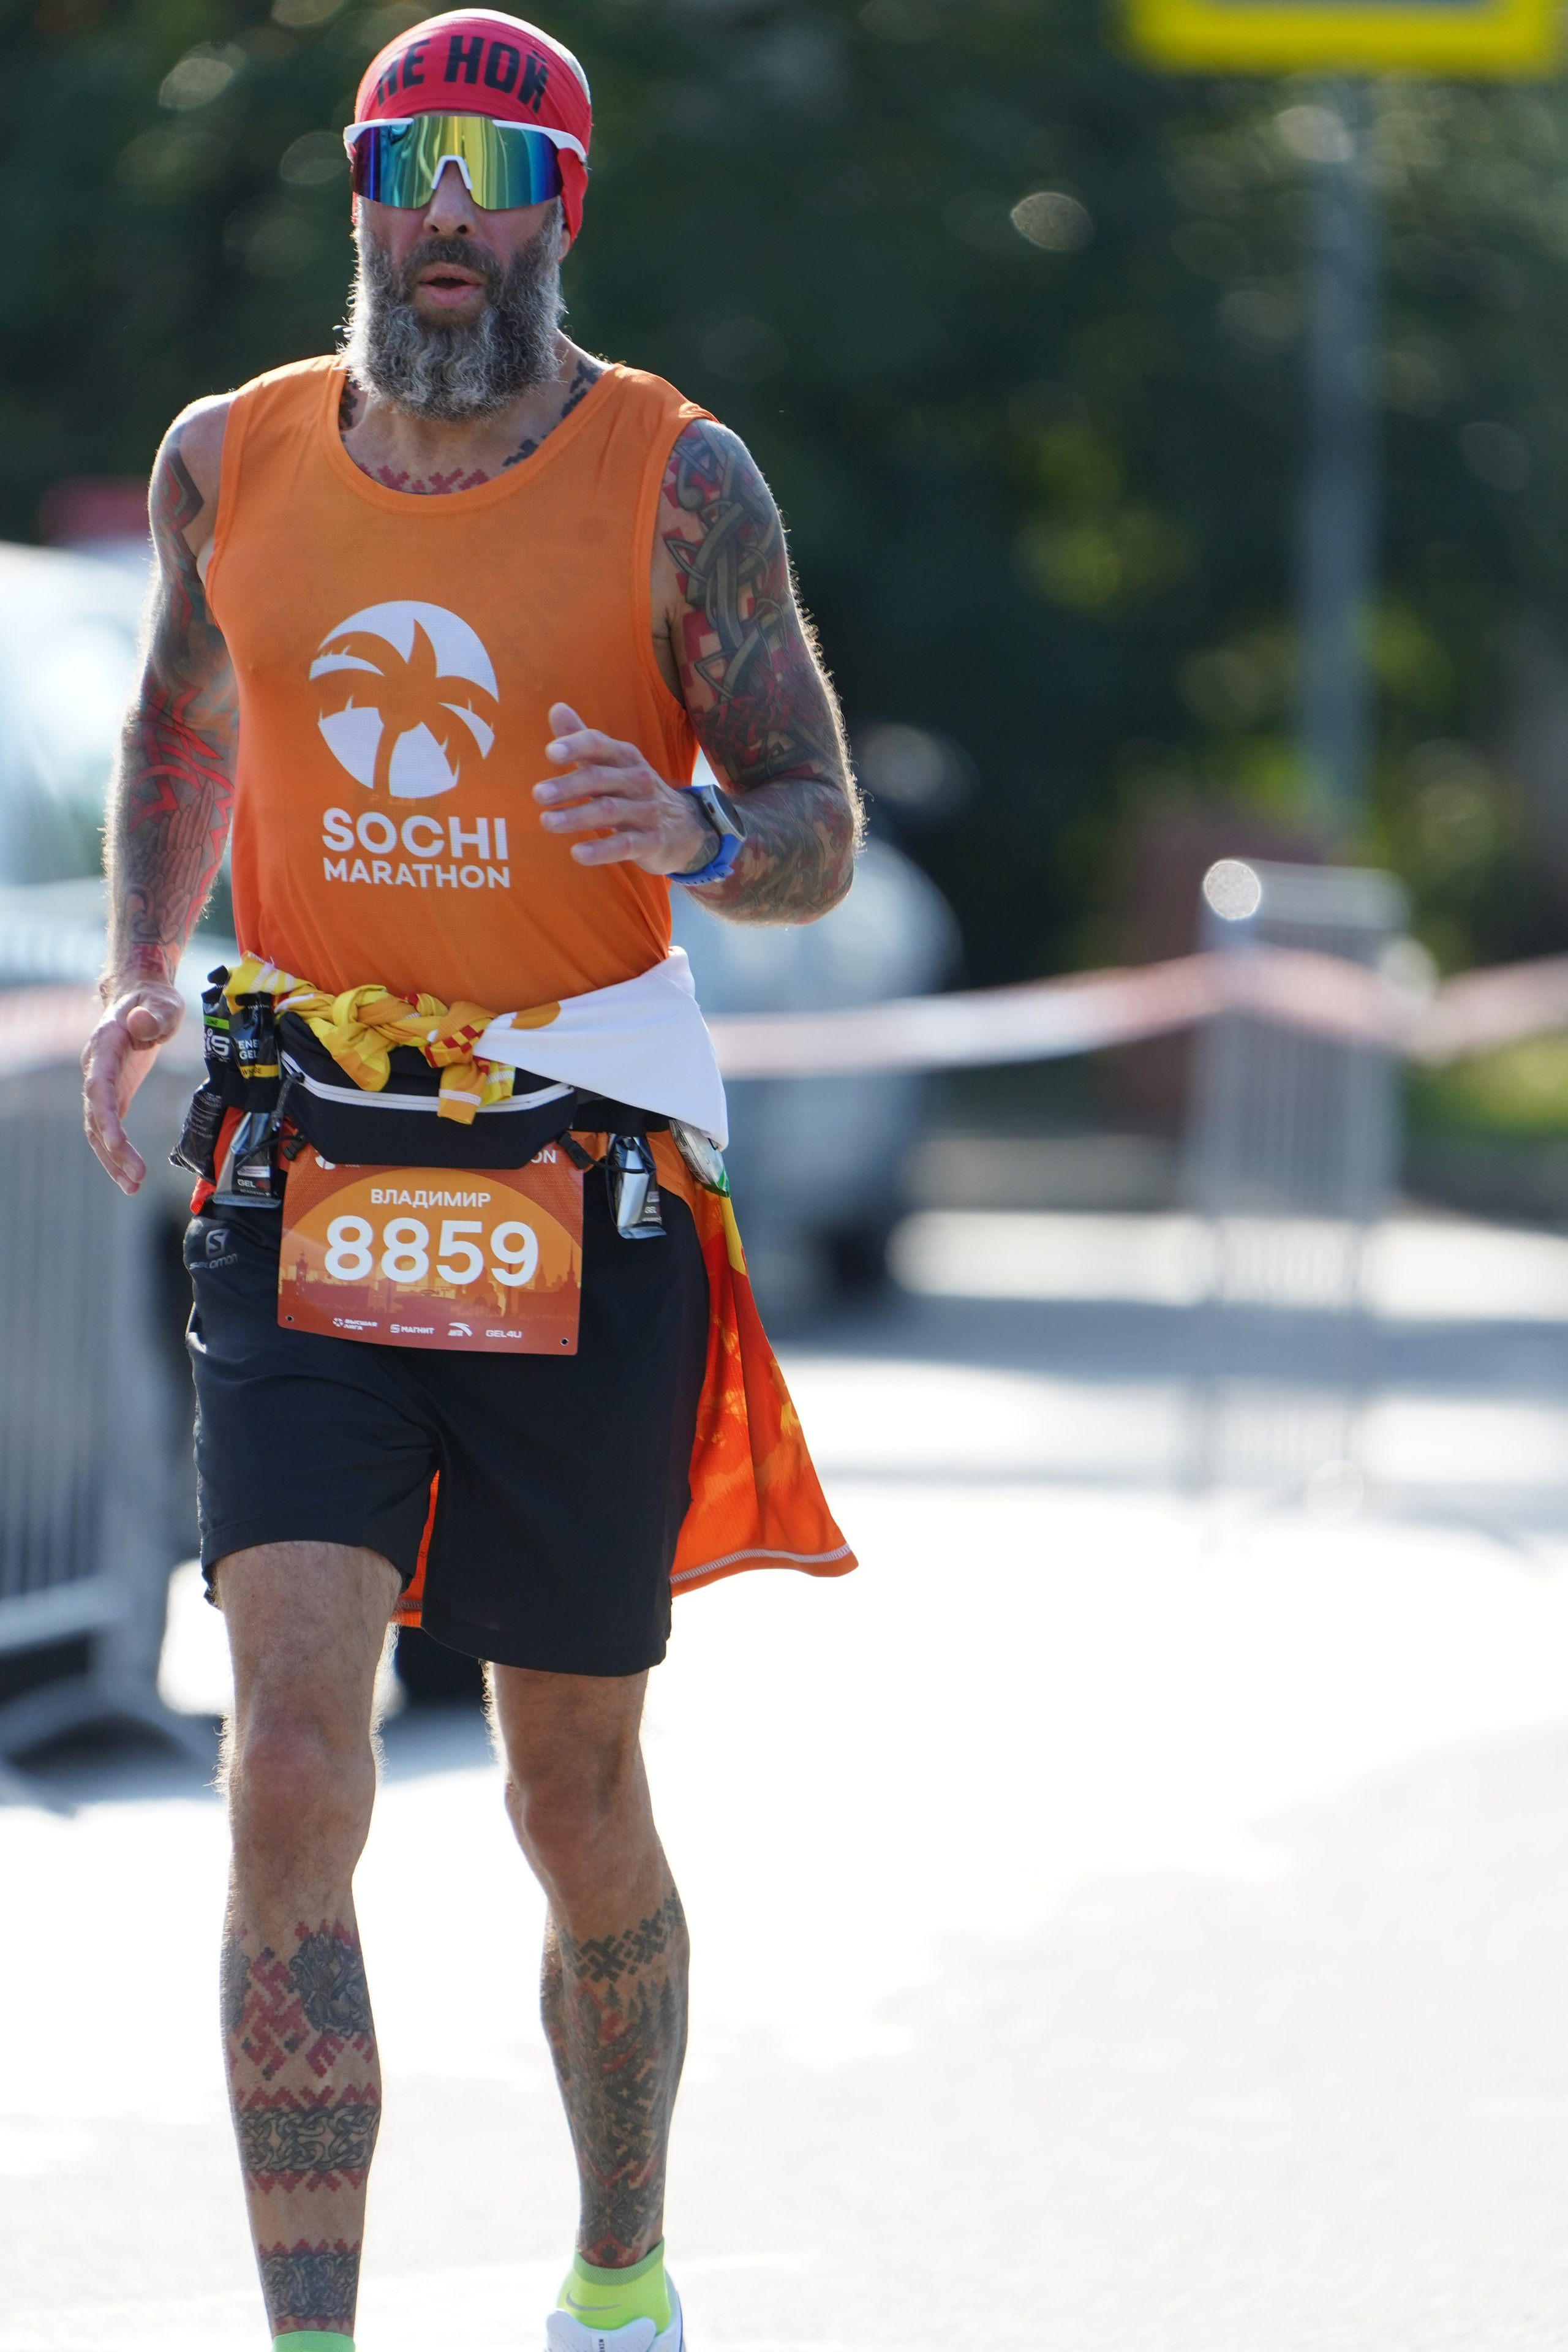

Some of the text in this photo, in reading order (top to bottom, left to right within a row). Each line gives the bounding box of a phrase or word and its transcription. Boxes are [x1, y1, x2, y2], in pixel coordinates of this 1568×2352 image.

[322, 807, 508, 860] SOCHI
[323, 857, 511, 889] MARATHON
[371, 1188, 491, 1209] ВЛАДИМИР
[324, 1215, 539, 1287] 8859
[401, 1325, 435, 1335] МАГНИТ
[485, 1329, 522, 1339] GEL4U
